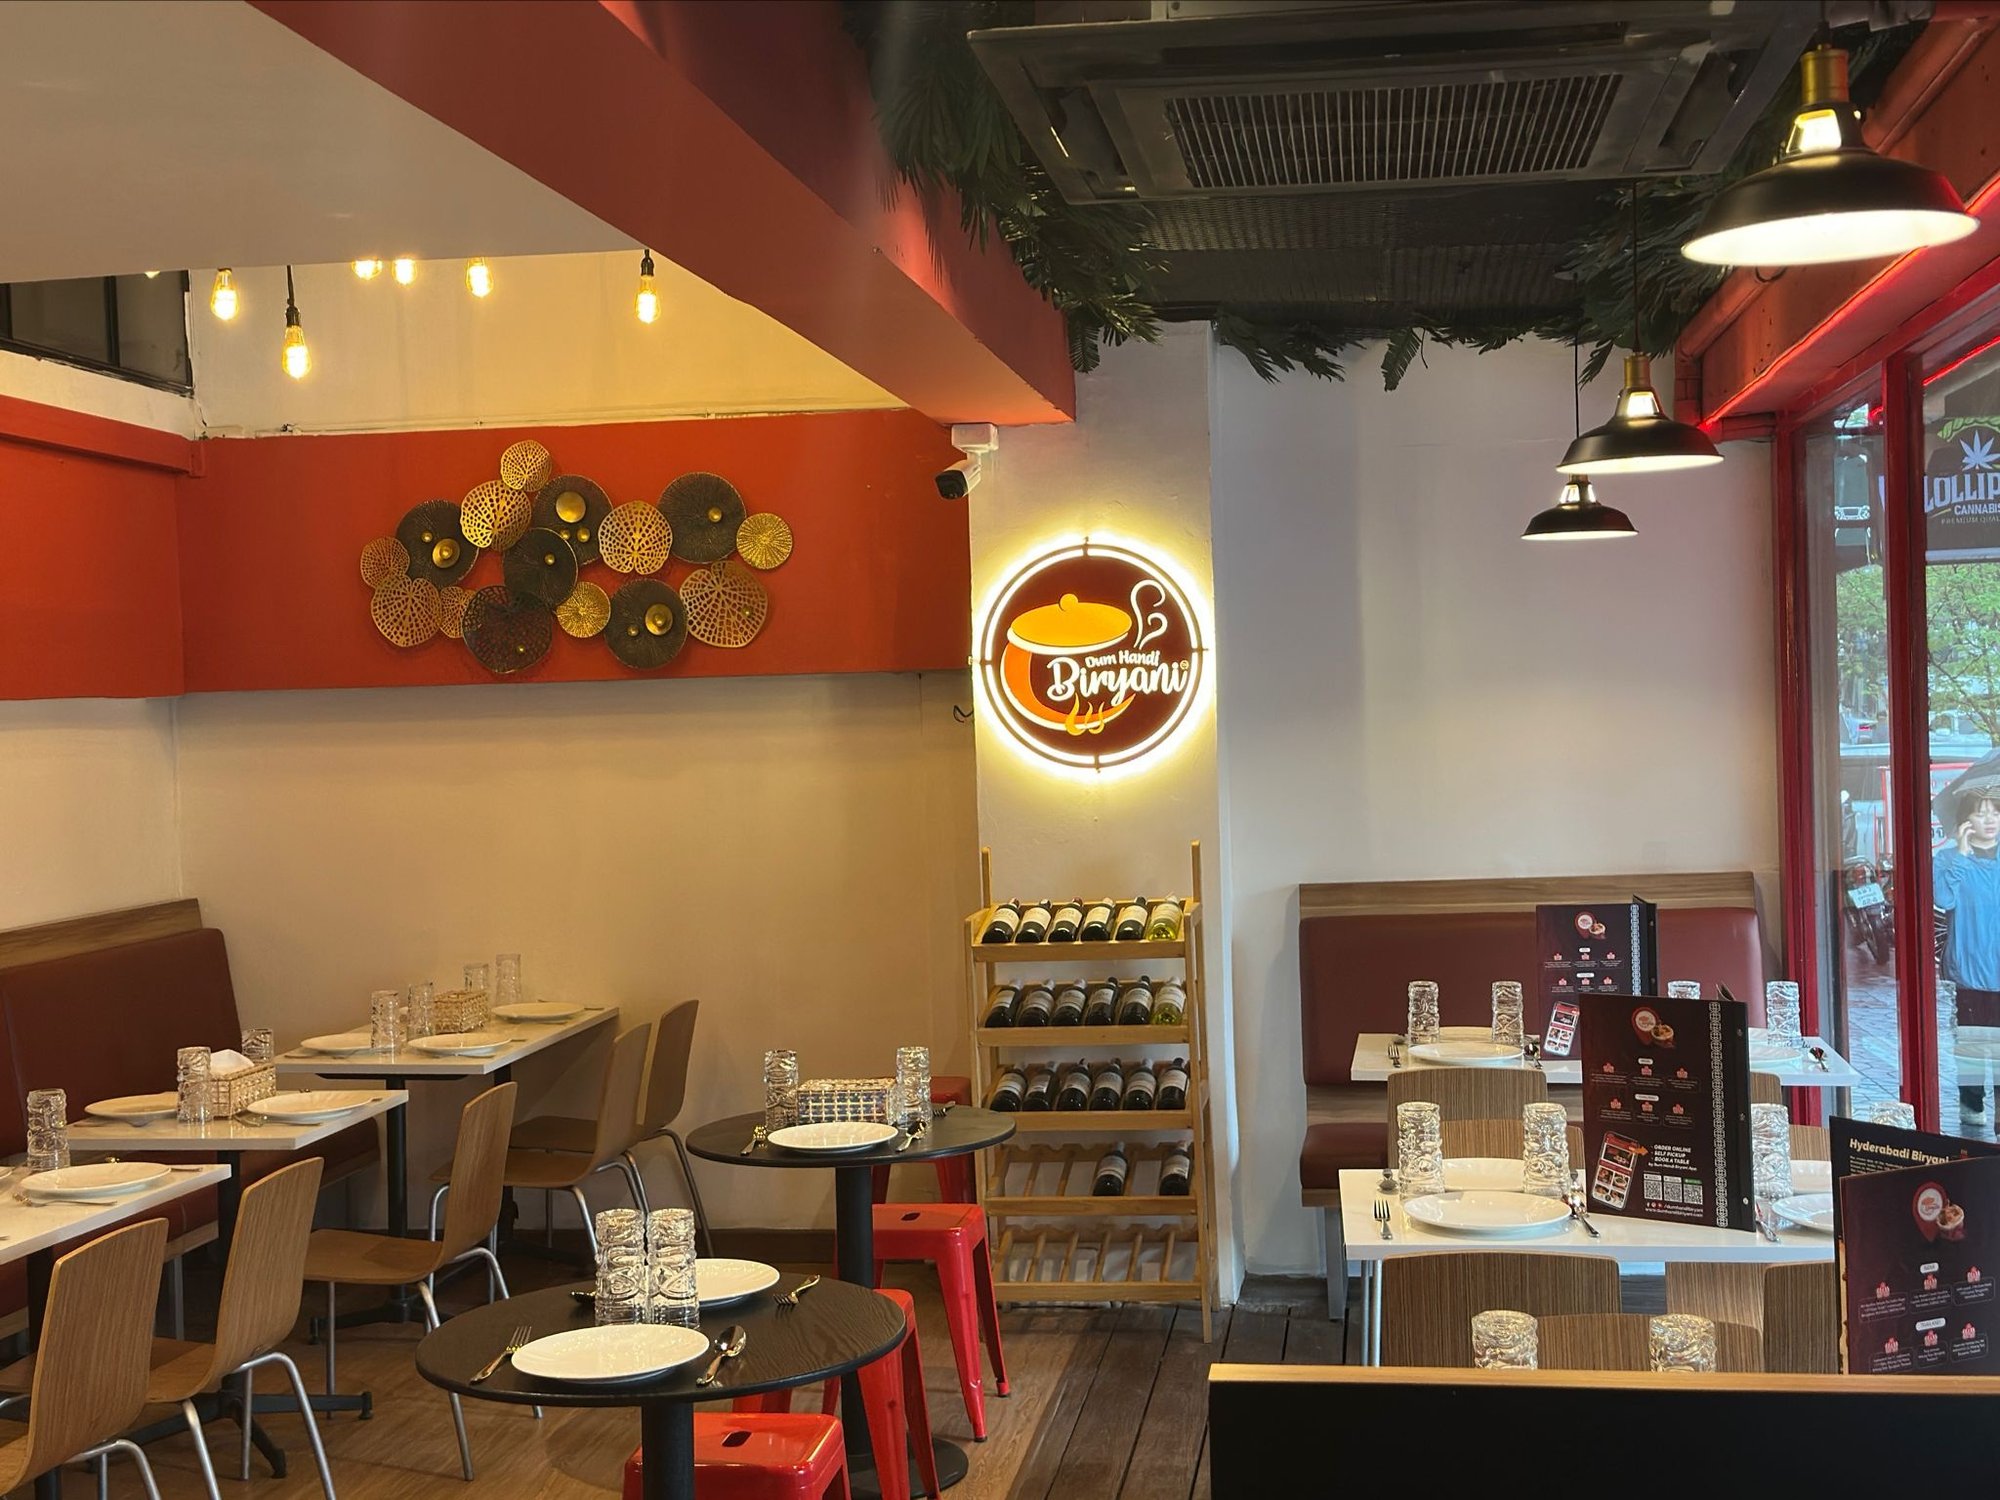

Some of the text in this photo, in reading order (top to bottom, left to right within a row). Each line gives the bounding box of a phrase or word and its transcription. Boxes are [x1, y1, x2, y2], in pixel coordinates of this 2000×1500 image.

[1084, 649, 1161, 668] Dum Handi
[1046, 656, 1188, 707] Biryani
[1849, 1138, 1910, 1159] Hyderabadi
